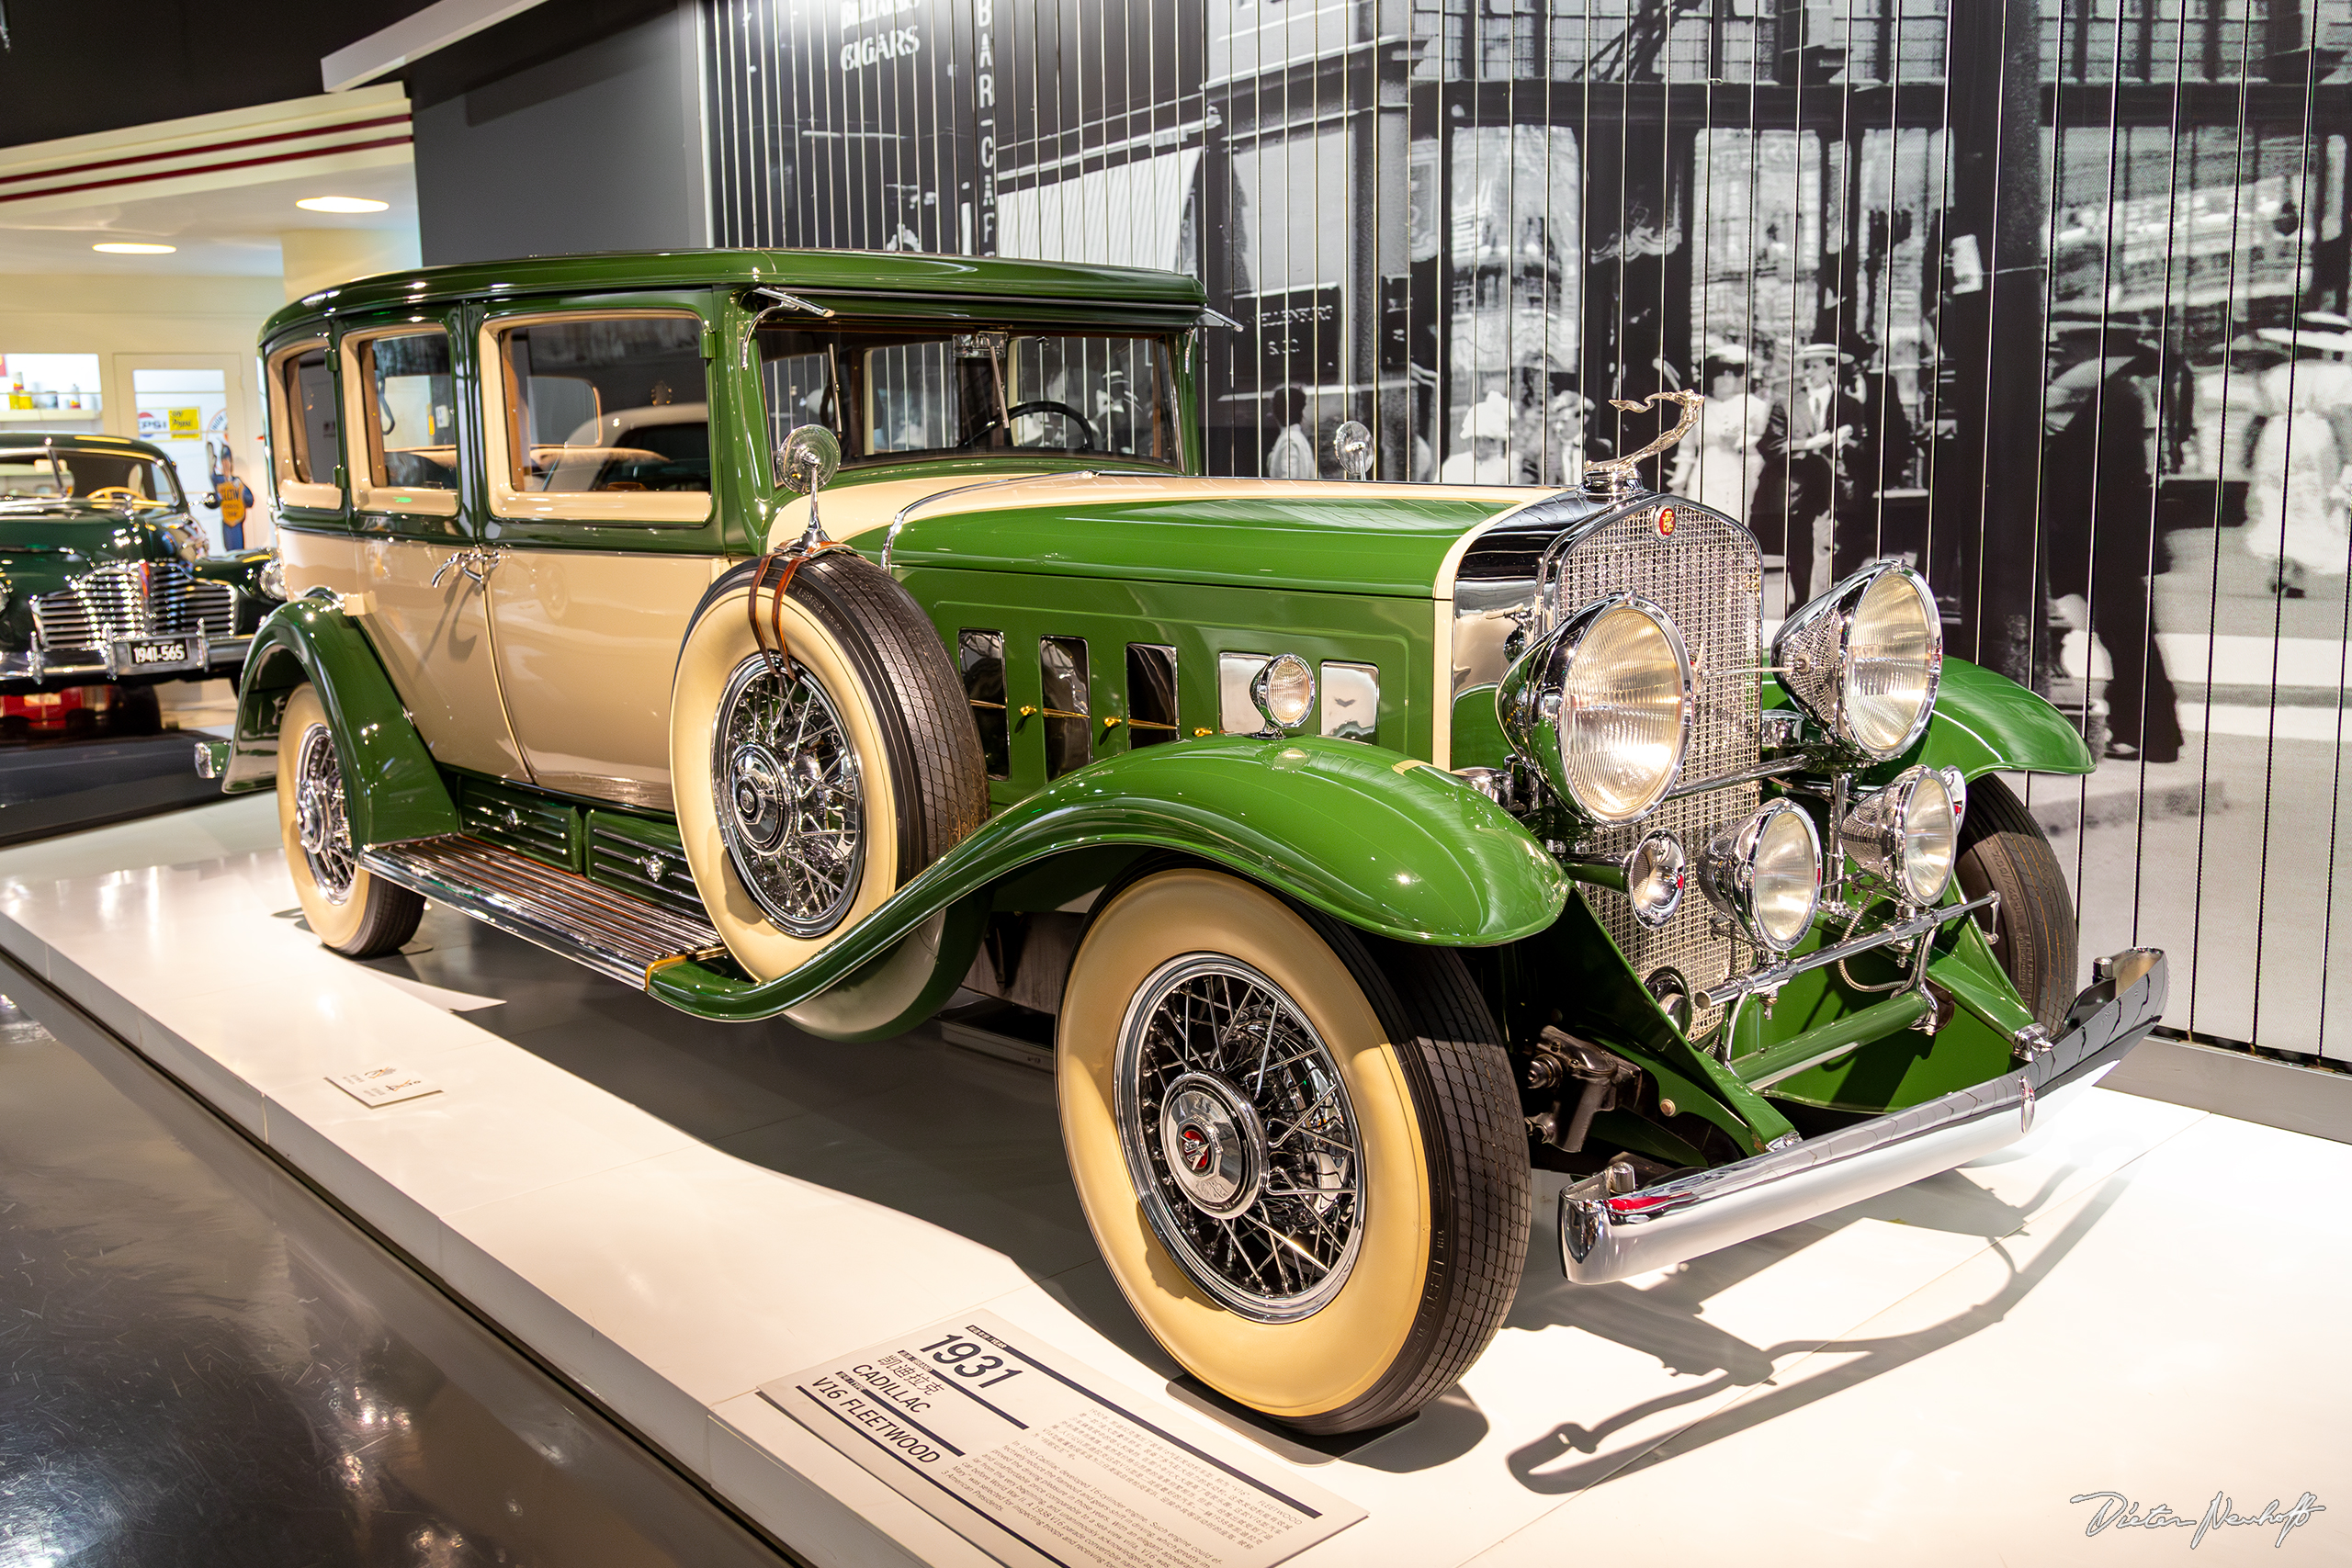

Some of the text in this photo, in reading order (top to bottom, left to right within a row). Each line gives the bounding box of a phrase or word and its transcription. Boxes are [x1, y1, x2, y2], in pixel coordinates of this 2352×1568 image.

[841, 25, 921, 72] CIGARS
[876, 1354, 945, 1397] 凯迪拉克
[920, 1334, 1023, 1389] 1931
[852, 1364, 932, 1414] CADILLAC
[812, 1377, 942, 1463] V16 FLEETWOOD
